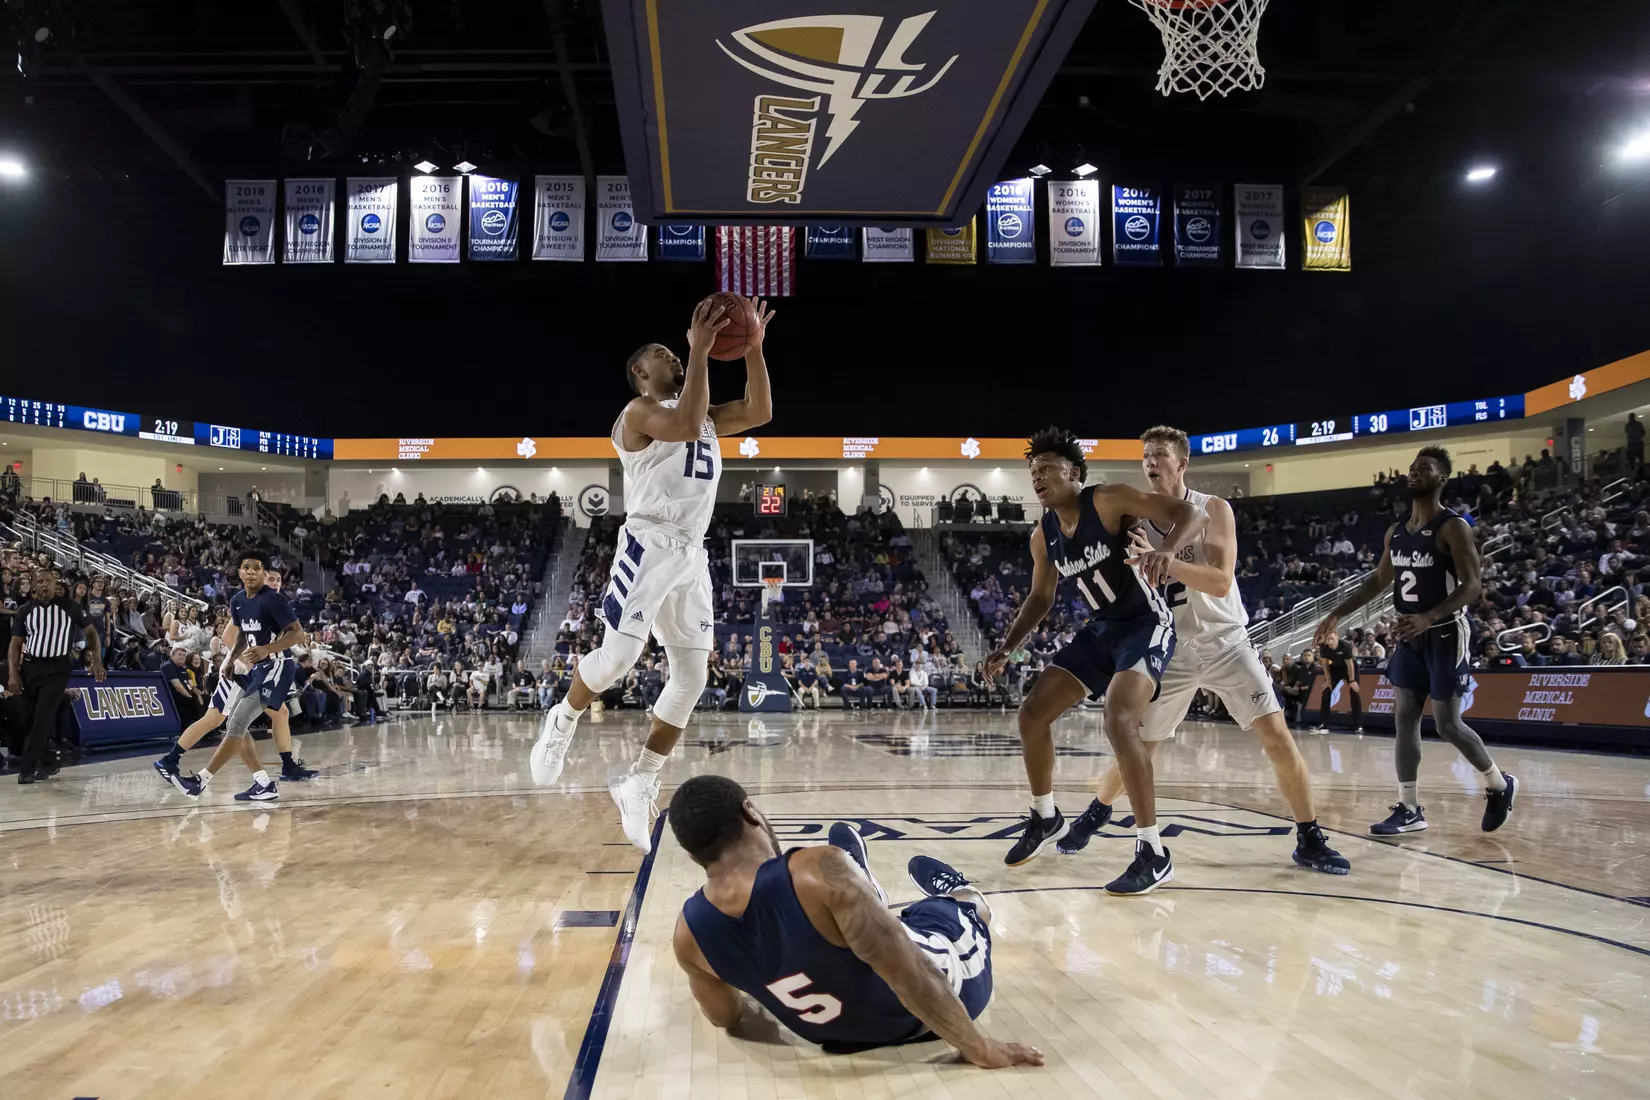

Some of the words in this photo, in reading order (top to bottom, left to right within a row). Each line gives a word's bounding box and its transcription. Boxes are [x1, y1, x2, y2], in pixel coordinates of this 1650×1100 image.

[747, 94, 822, 204] LANCERS
[236, 186, 264, 196] 2018
[295, 185, 324, 194] 2018
[358, 184, 385, 193] 2017
[422, 184, 450, 193] 2016
[482, 182, 509, 192] 2016
[546, 183, 574, 192] 2015
[608, 183, 628, 192] 201
[1059, 188, 1086, 196] 2016
[1122, 187, 1151, 198] 2017
[1184, 190, 1212, 199] 2017
[1245, 191, 1273, 201] 2017
[8, 398, 16, 406] 12
[21, 400, 28, 408] 15
[10, 406, 14, 414] 2
[84, 410, 125, 432] CBU
[155, 419, 178, 435] 2:19
[1370, 415, 1387, 433] 30
[1311, 420, 1335, 436] 2:19
[1201, 433, 1238, 453] CBU
[1262, 428, 1278, 446] 26
[683, 440, 714, 480] 15
[761, 497, 780, 513] 22
[1084, 541, 1111, 568] State
[1412, 550, 1434, 567] State
[1077, 569, 1116, 610] 11
[1400, 570, 1419, 602] 2
[759, 626, 772, 673] CBU
[1528, 674, 1590, 687] RIVERSIDE
[80, 686, 164, 720] LANCERS
[1523, 692, 1574, 704] MEDICAL
[1368, 702, 1393, 713] CLINIC
[1518, 708, 1556, 721] CLINIC
[764, 972, 844, 1024] 5
